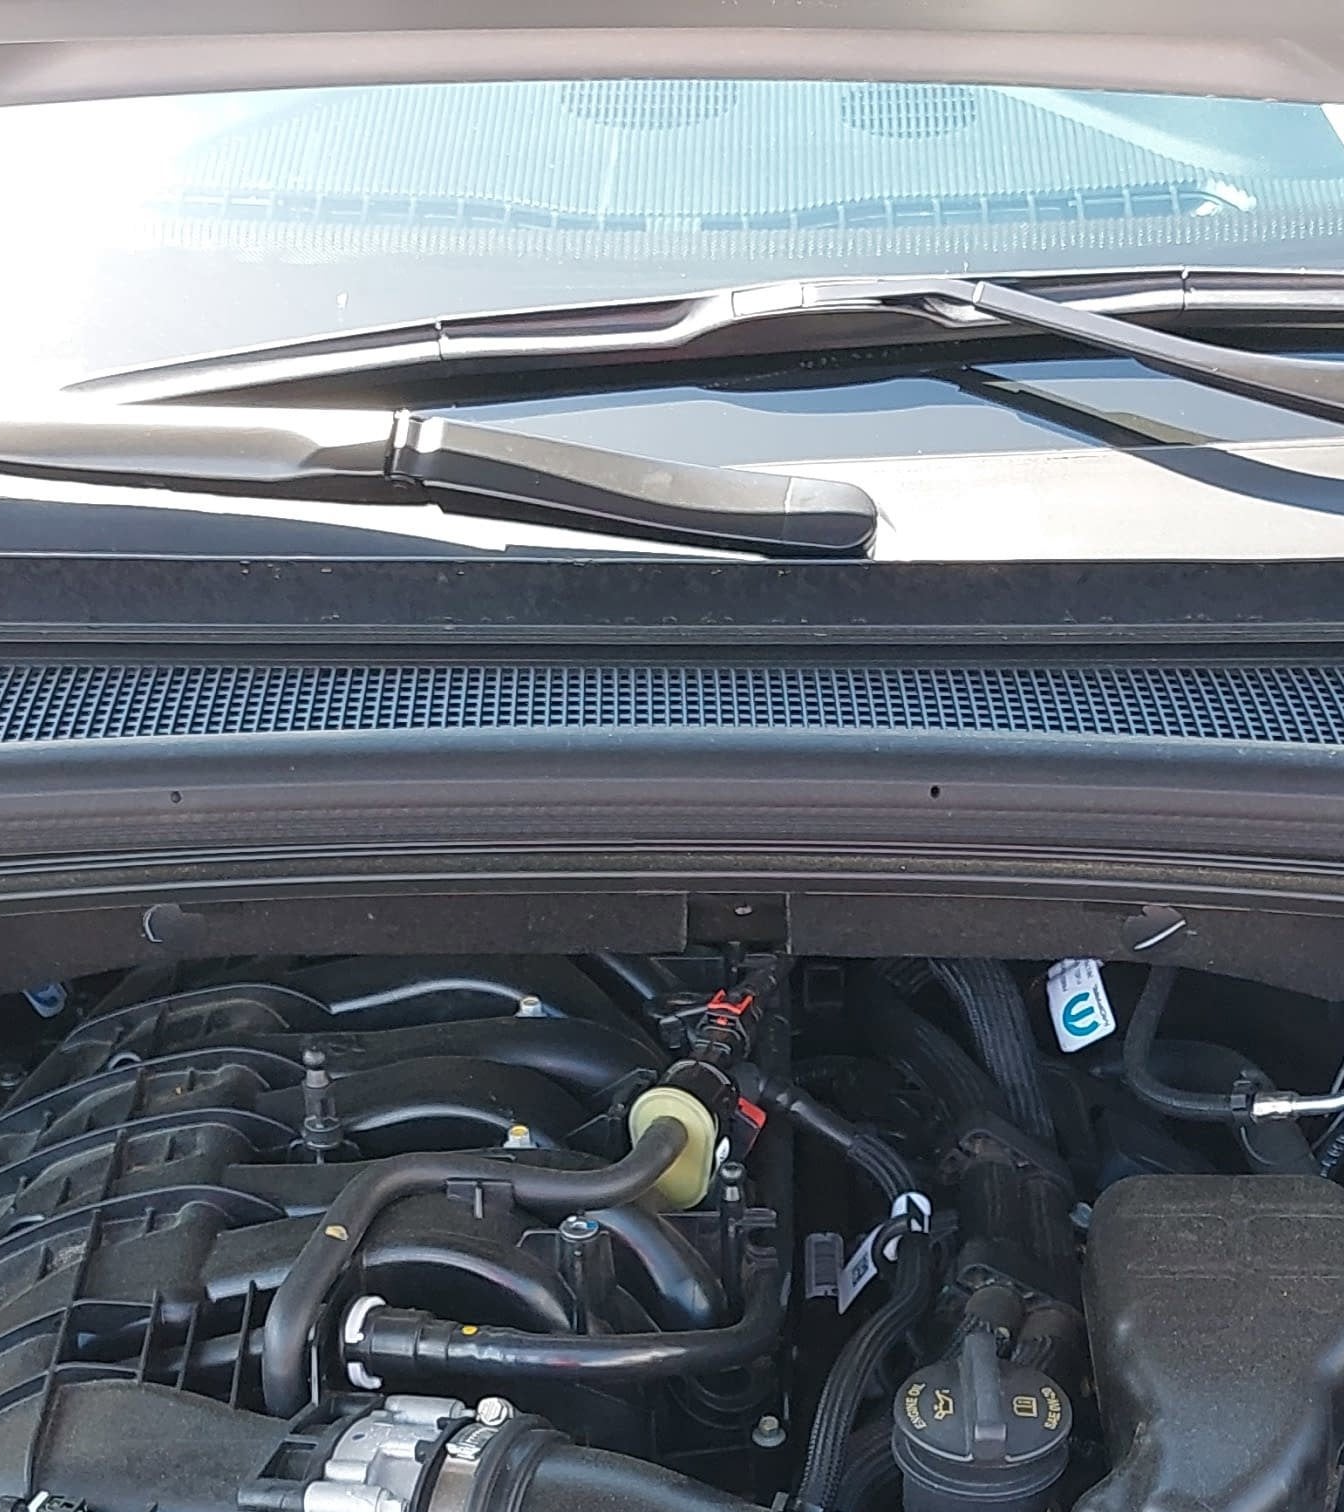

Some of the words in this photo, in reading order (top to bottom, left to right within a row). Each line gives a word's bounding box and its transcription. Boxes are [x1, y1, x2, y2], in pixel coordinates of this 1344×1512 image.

[908, 1383, 926, 1397] OIL
[906, 1397, 927, 1430] ENGINE
[1044, 1411, 1061, 1430] SAE
